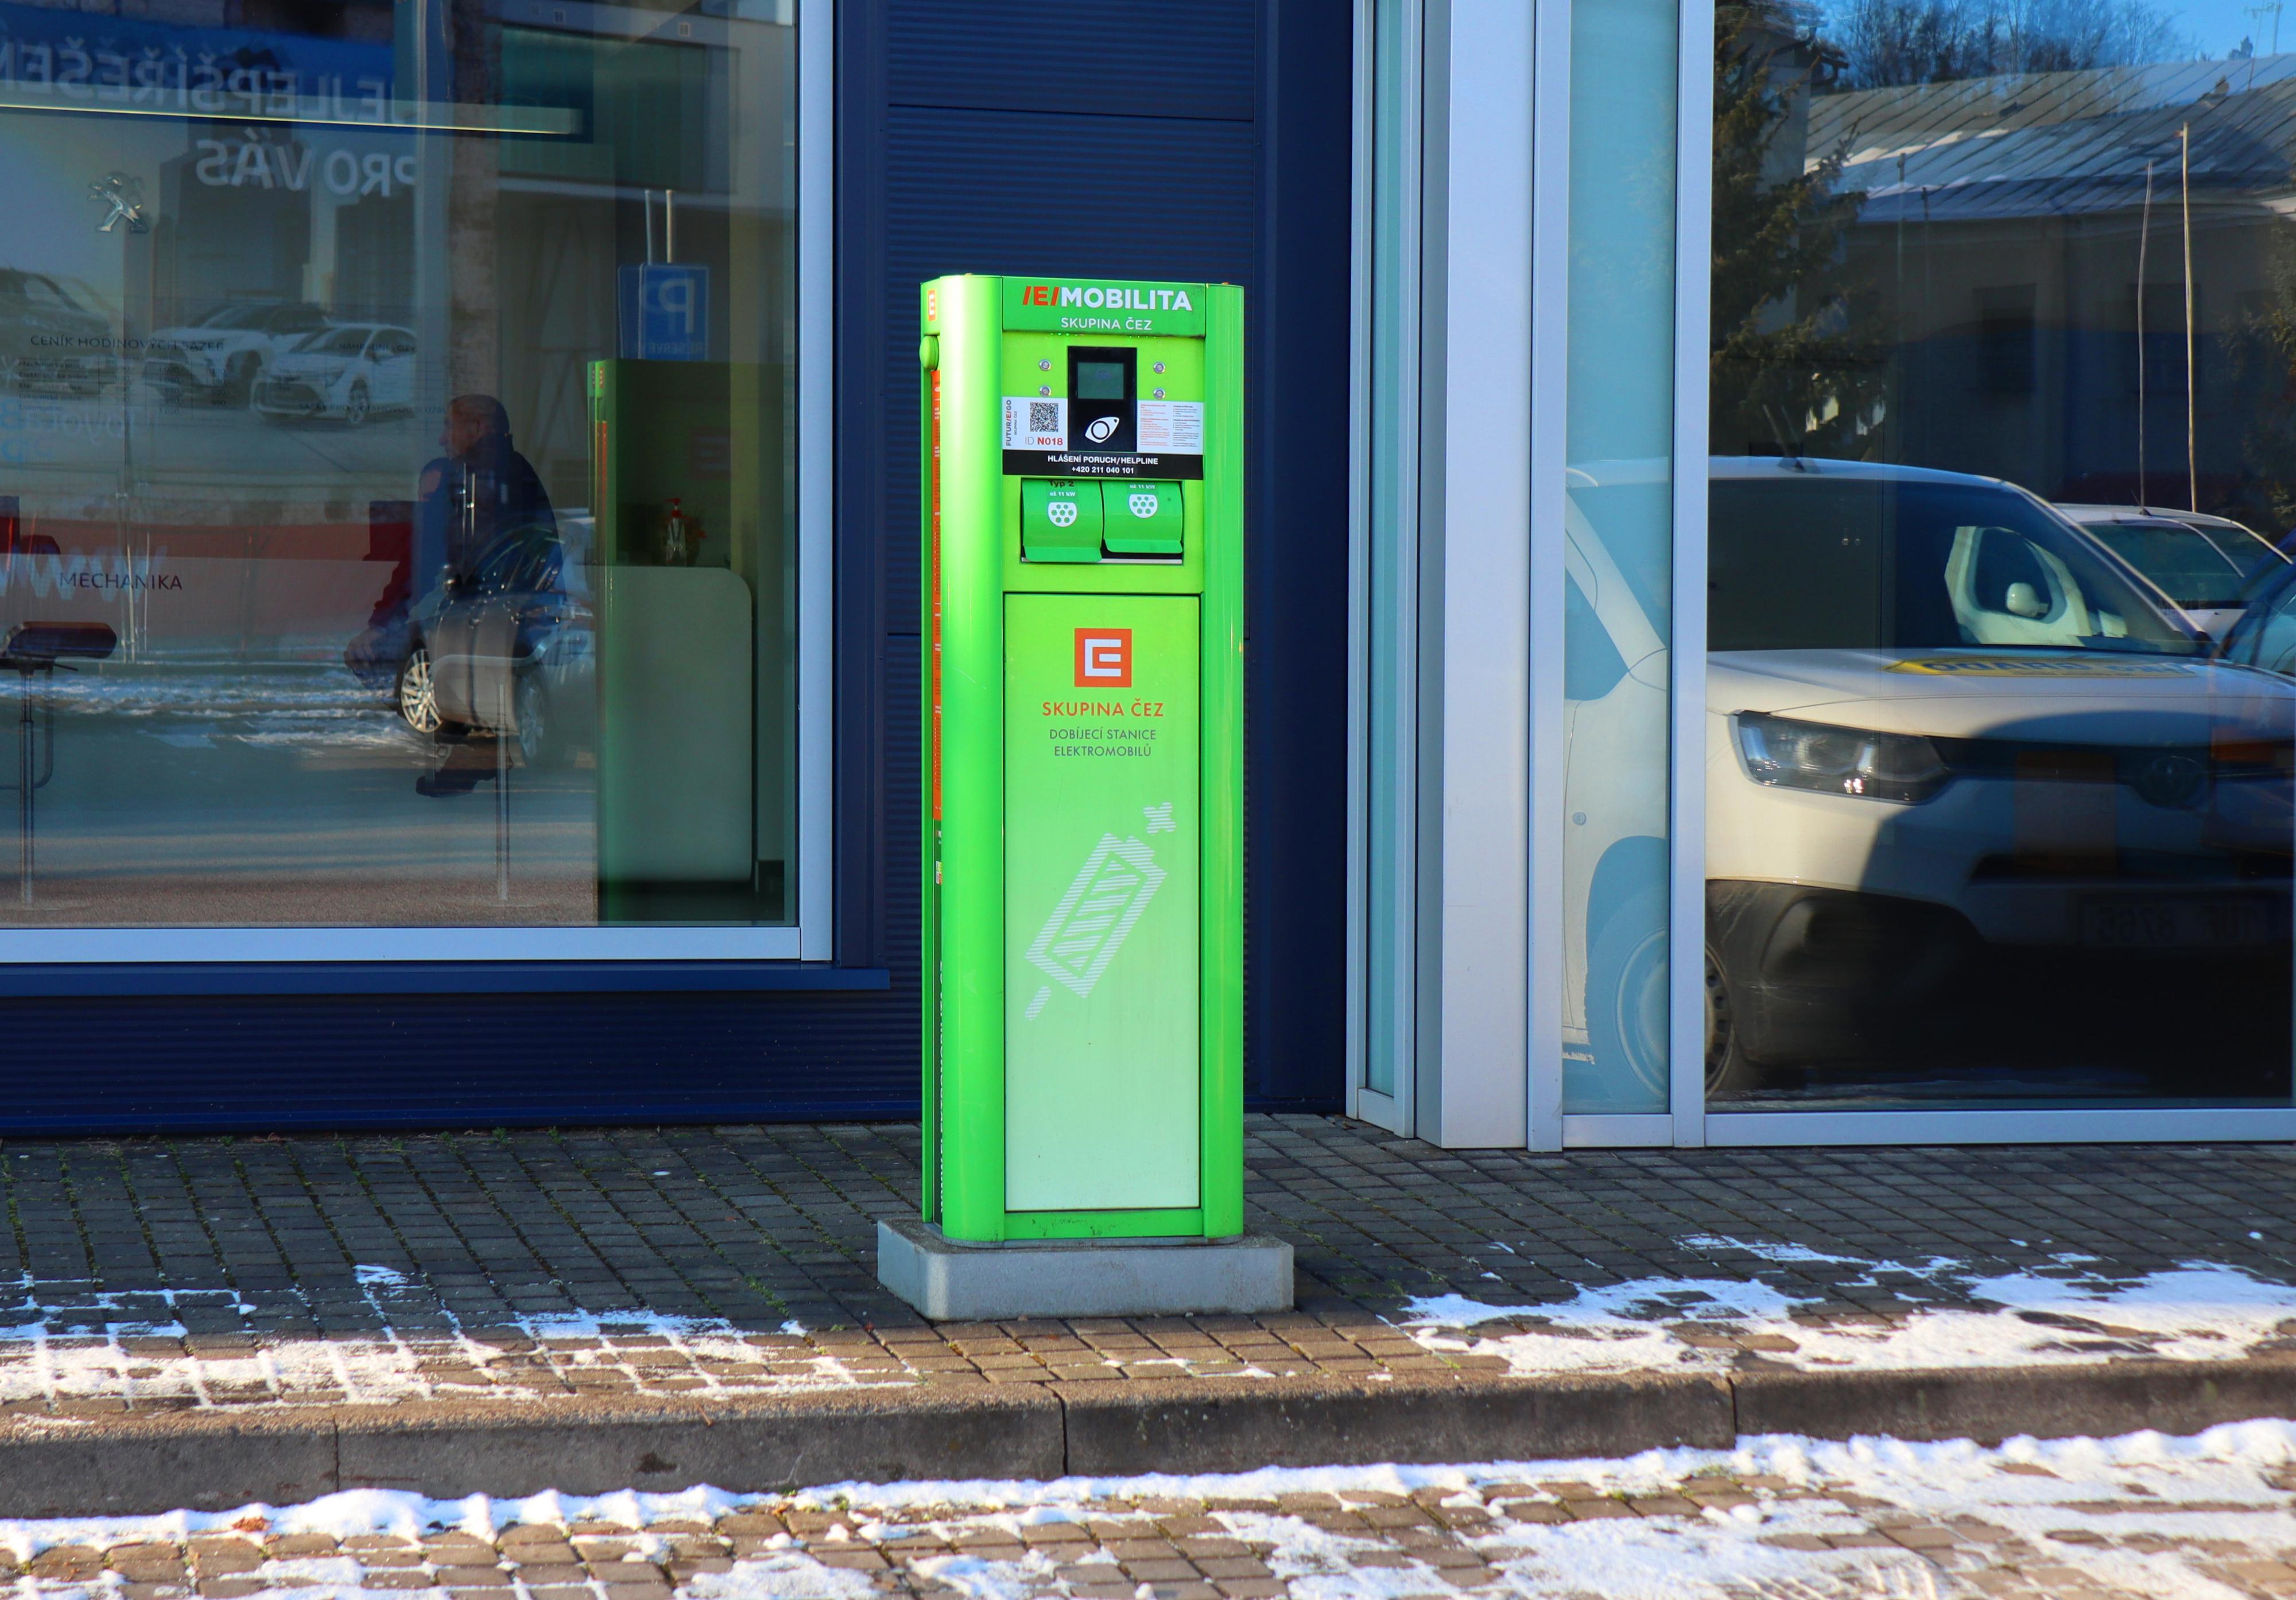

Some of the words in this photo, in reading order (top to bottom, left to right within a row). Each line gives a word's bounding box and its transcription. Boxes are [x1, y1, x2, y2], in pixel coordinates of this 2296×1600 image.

[1061, 317, 1120, 330] SKUPINA
[1125, 316, 1153, 331] ČEZ
[31, 334, 73, 347] CENÍK
[1025, 436, 1034, 445] ID
[1037, 437, 1063, 445] N018
[1048, 454, 1081, 464] HLÁŠENÍ
[1083, 456, 1158, 465] PORUCH/HELPLINE
[1071, 465, 1090, 473] +420
[1106, 466, 1120, 474] 040
[59, 572, 183, 590] MECHANIKA
[1042, 702, 1124, 717] SKUPINA
[1131, 698, 1164, 717] ČEZ
[1049, 727, 1103, 740] DOBÍJECÍ
[1107, 729, 1157, 740] STANICE
[1054, 743, 1151, 757] ELEKTROMOBILŮ
